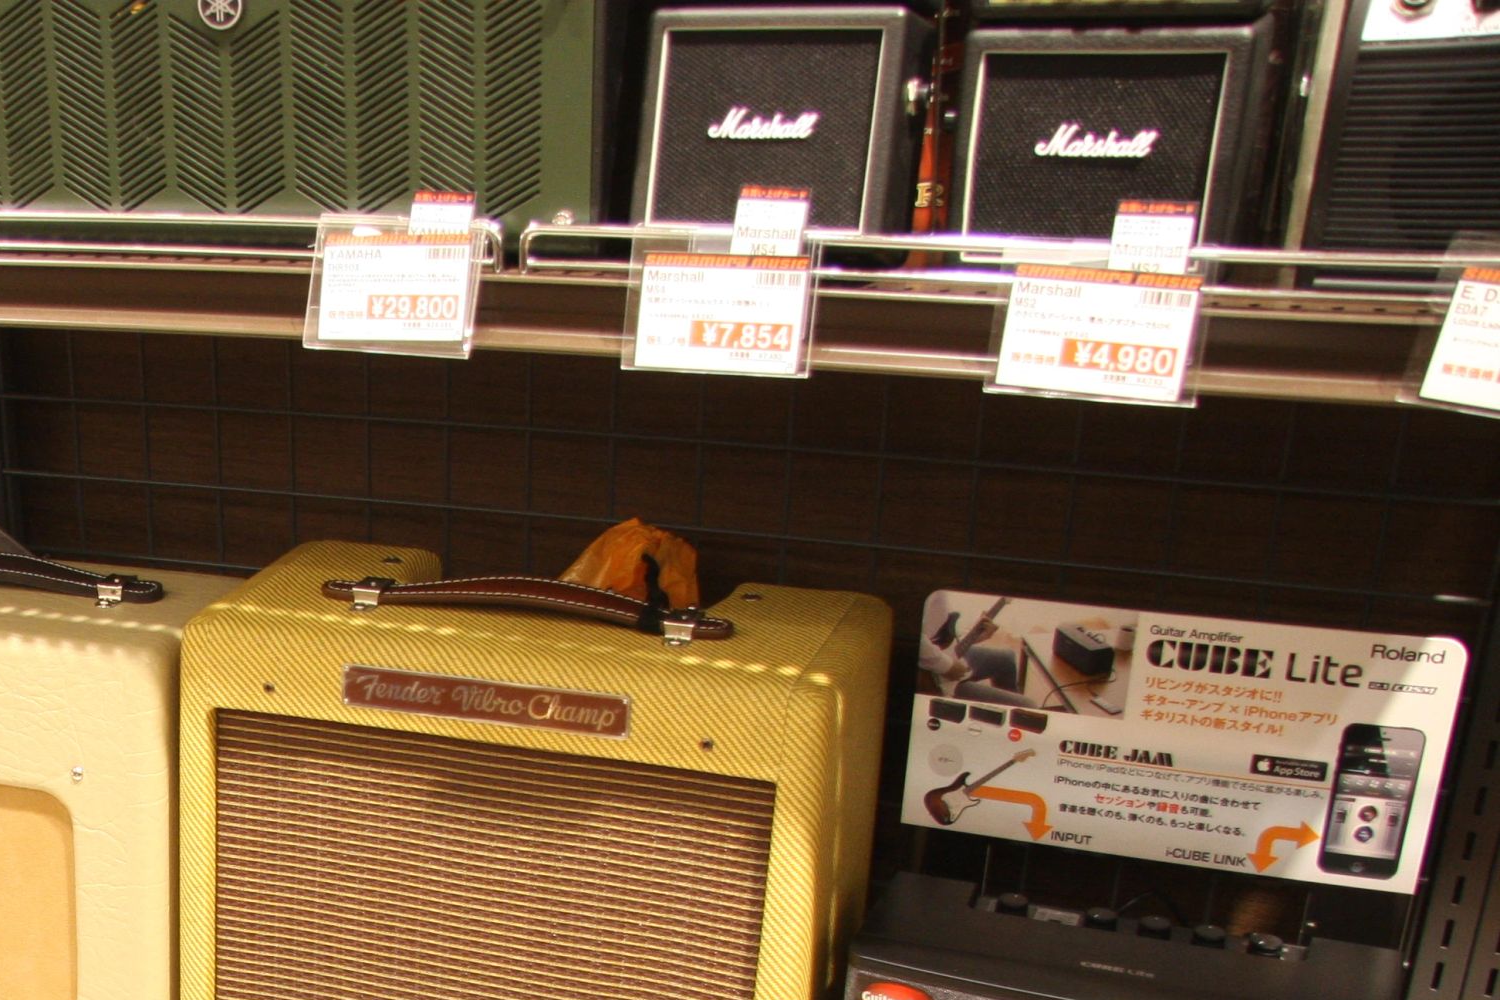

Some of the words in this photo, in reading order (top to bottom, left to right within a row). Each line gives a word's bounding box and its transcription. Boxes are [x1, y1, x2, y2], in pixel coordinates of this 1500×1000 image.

[706, 107, 820, 140] Marshall
[1034, 122, 1161, 158] Marshall
[736, 226, 797, 240] Marshall
[329, 248, 383, 260] YAMAHA
[647, 270, 705, 282] Marshall
[1016, 281, 1082, 298] Marshall
[371, 296, 456, 319] ¥29,800
[702, 321, 790, 350] ¥7,854
[1073, 340, 1174, 375] ¥4,980
[1150, 624, 1187, 639] Guitar
[1189, 628, 1244, 644] Amplifier
[1146, 638, 1274, 680] CUBE
[1284, 652, 1364, 688] Lite
[1370, 644, 1446, 665] Roland
[356, 674, 442, 705] Fender
[452, 684, 525, 716] Vibro
[527, 694, 619, 731] Champ
[1059, 739, 1119, 760] CUBE
[1123, 748, 1173, 767] JAM
[1272, 764, 1292, 778] App
[1292, 766, 1321, 779] Store
[1051, 830, 1093, 846] INPUT
[1165, 847, 1210, 863] i-CUBE
[1213, 852, 1247, 868] LINK
